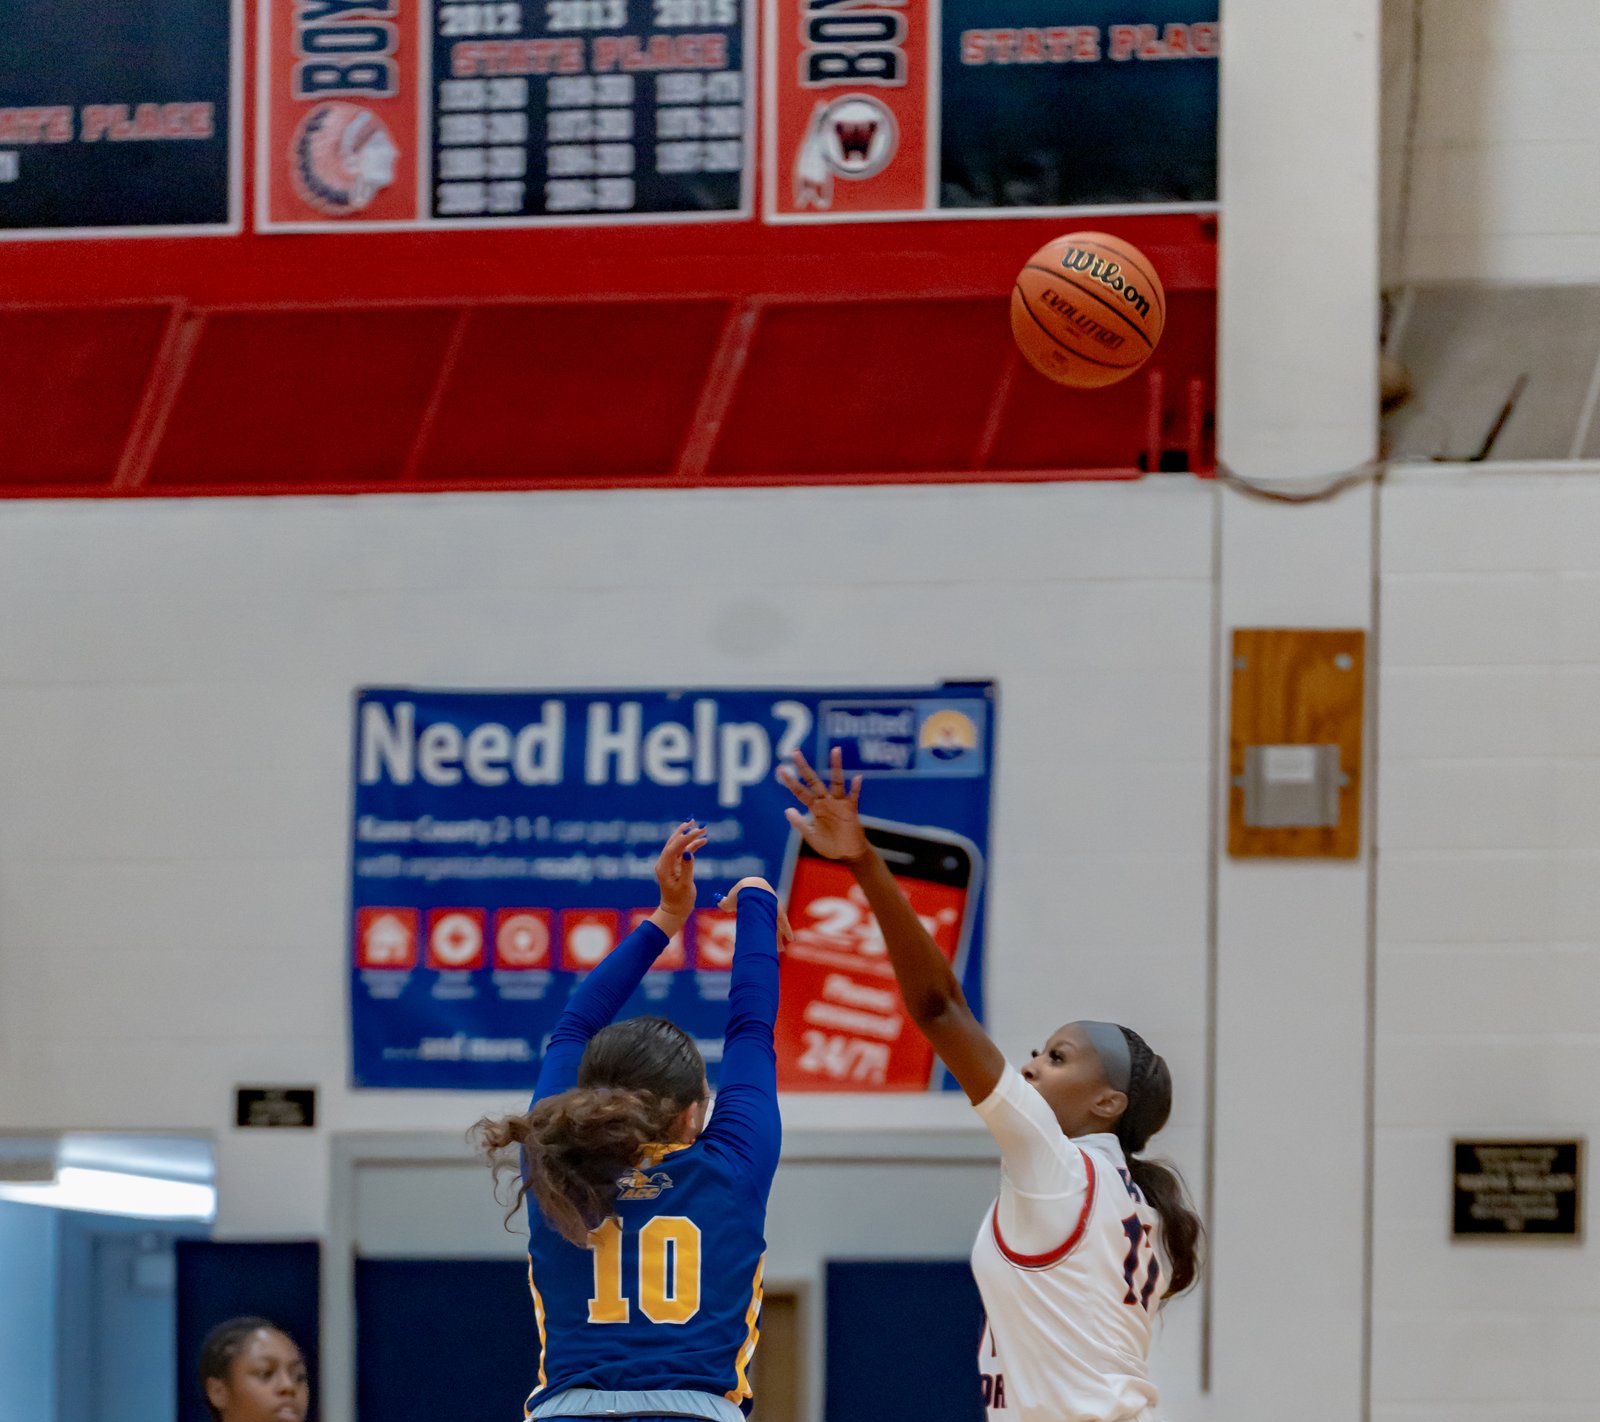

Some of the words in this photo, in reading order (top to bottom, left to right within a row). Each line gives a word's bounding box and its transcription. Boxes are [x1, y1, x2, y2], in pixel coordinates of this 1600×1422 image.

[290, 0, 398, 100] BOY
[451, 38, 584, 77] STATE
[592, 33, 728, 71] PLACE
[798, 0, 908, 89] BO
[960, 26, 1100, 65] STATE
[1107, 22, 1221, 61] PLAC
[80, 102, 215, 142] PLACE
[1040, 289, 1126, 350] EVOLUTION
[1061, 247, 1151, 320] Wilson
[360, 700, 566, 786] Need
[585, 699, 814, 808] Help?
[586, 1215, 701, 1324] 10
